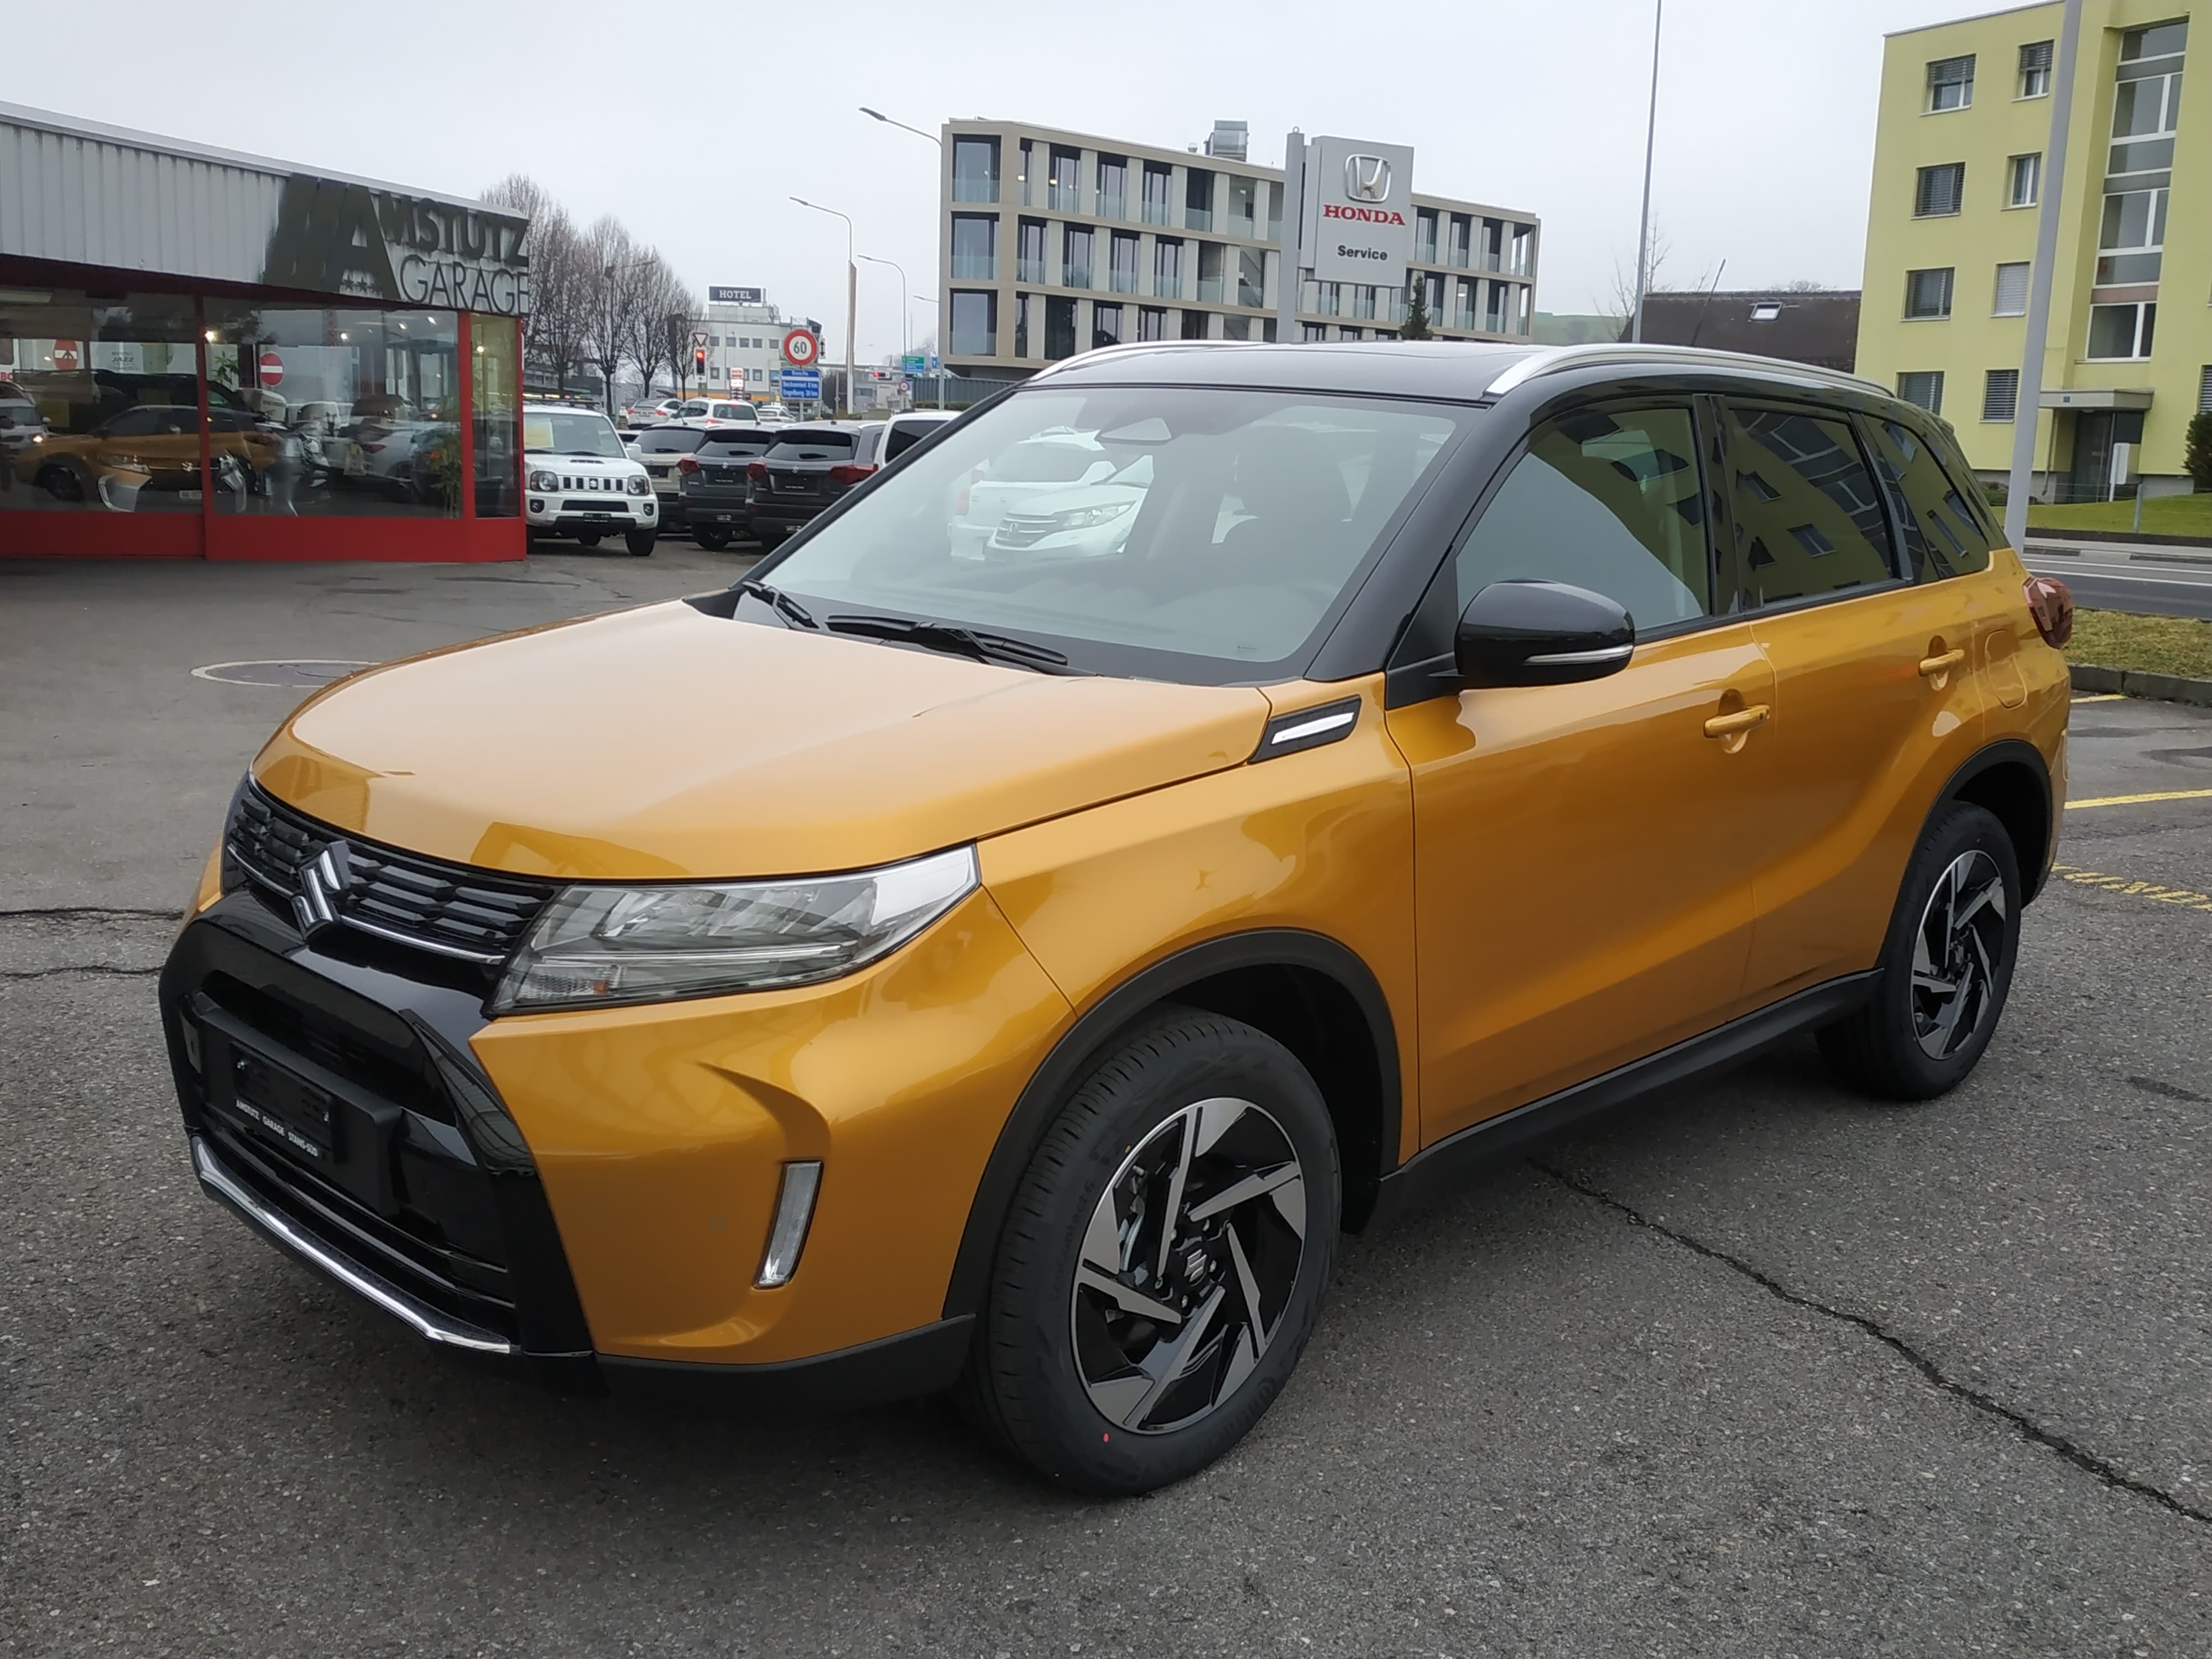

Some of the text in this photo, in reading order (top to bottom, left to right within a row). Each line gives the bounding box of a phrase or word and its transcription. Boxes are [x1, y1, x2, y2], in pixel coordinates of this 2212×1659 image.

[1323, 205, 1406, 226] HONDA
[1337, 245, 1388, 260] Service
[400, 254, 529, 315] GARAGE
[719, 290, 752, 299] HOTEL
[793, 341, 807, 354] 60
